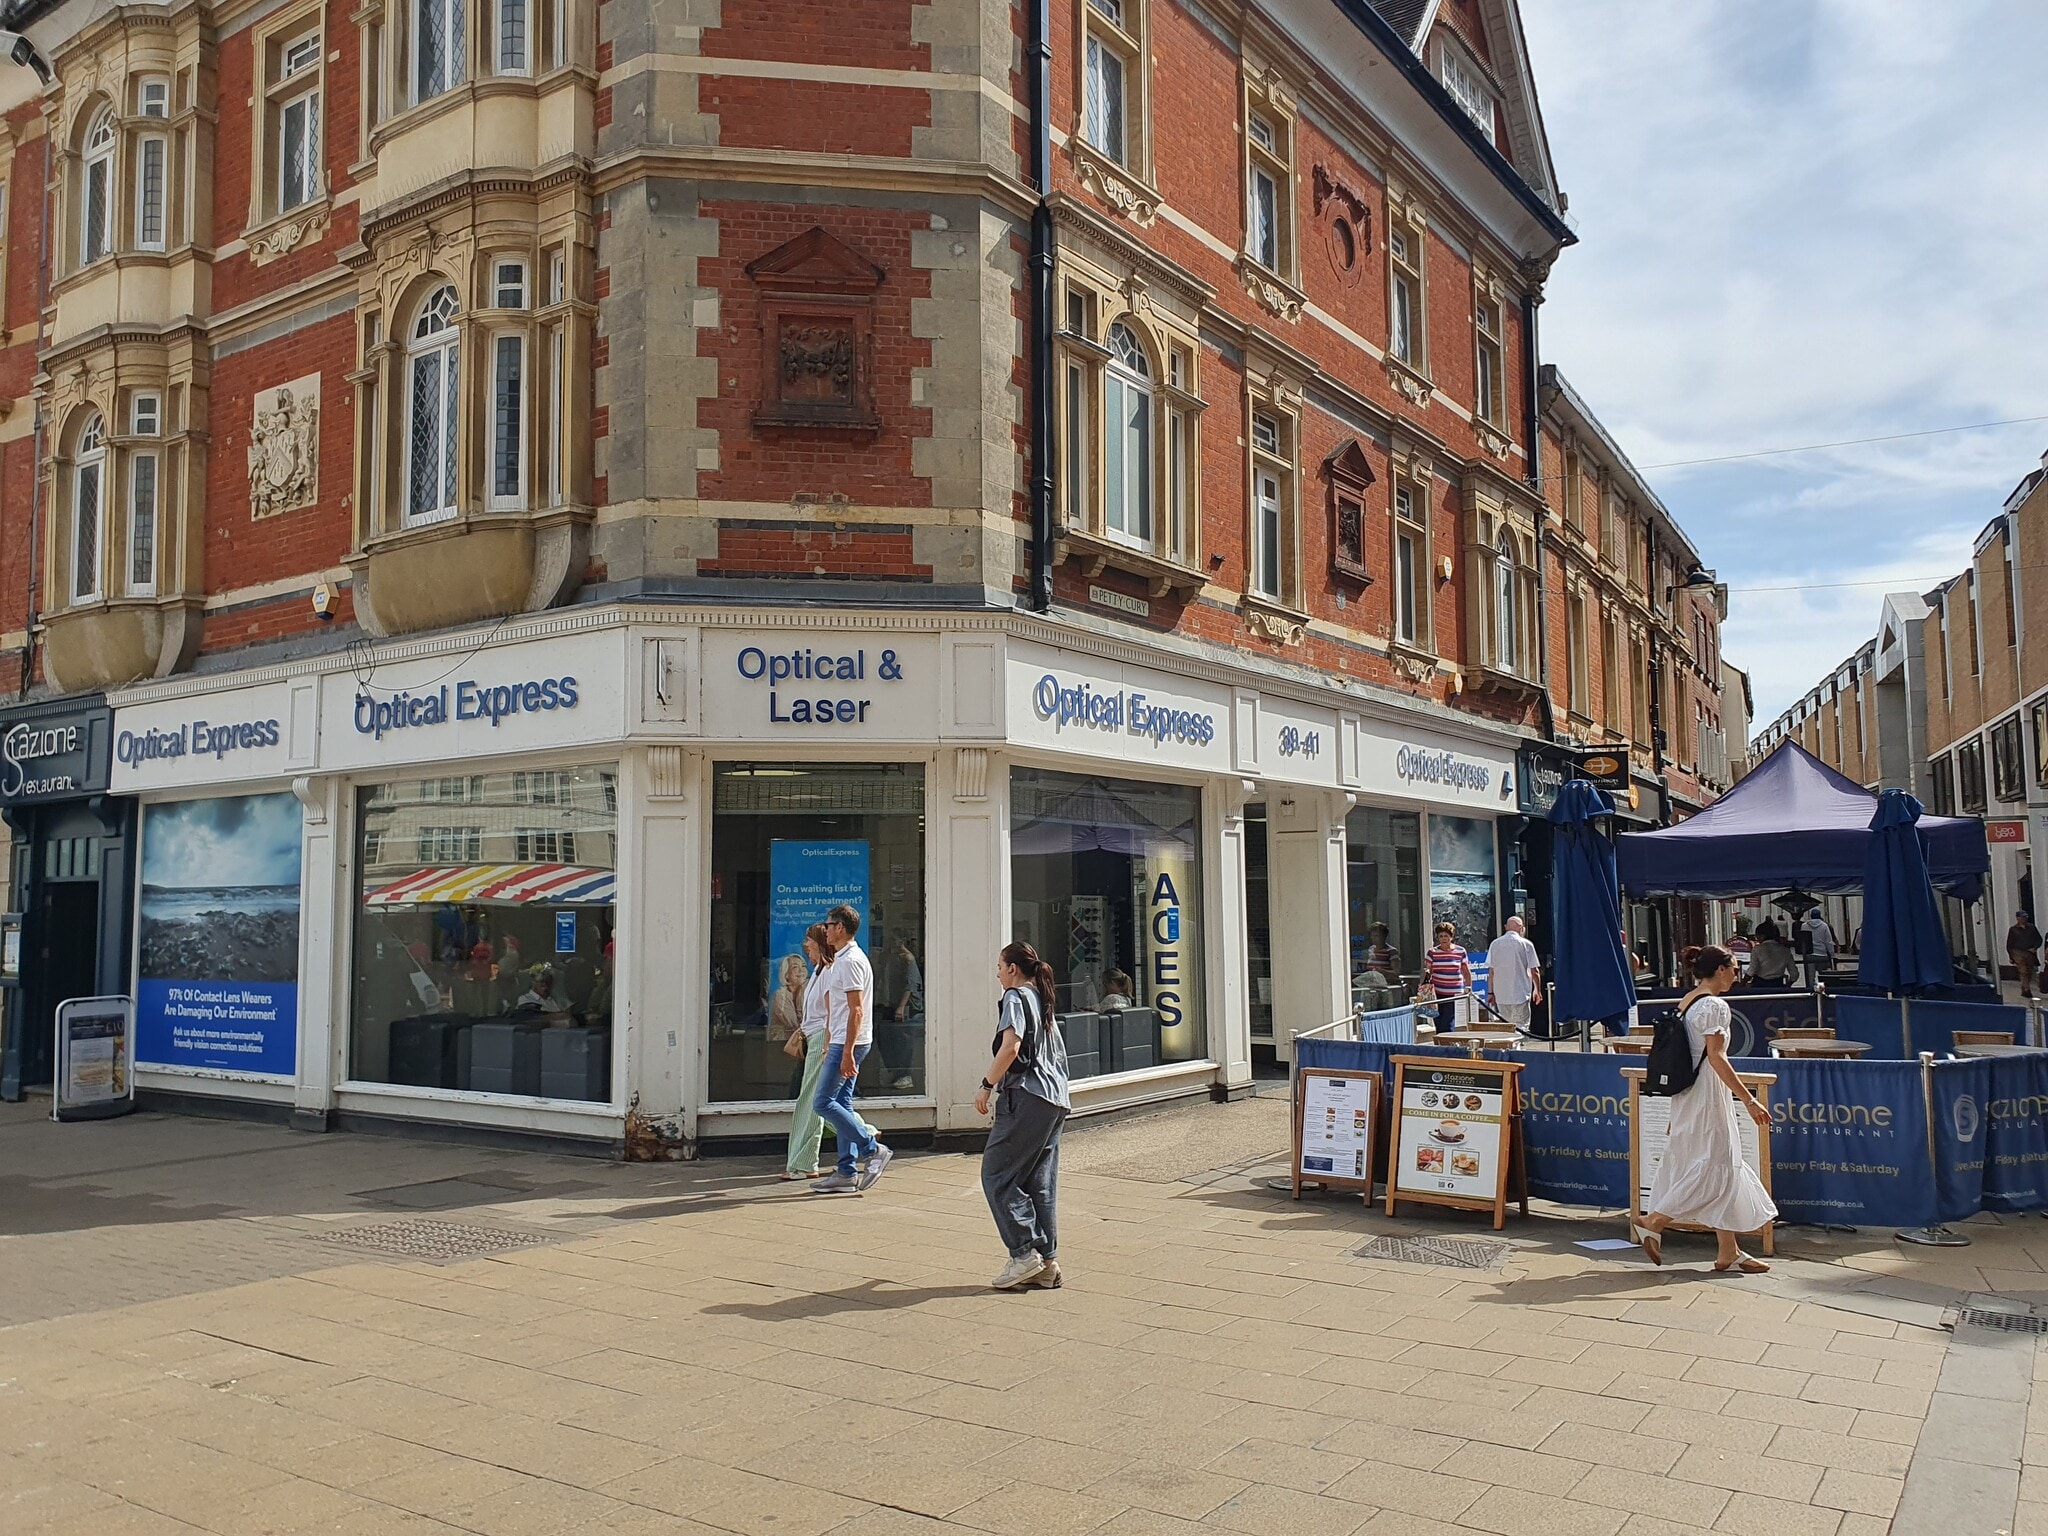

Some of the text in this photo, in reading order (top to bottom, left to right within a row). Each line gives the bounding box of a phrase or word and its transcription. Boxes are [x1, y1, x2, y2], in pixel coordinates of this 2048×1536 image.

[1099, 590, 1147, 614] PETTY CURY
[737, 647, 903, 687] Optical &
[354, 676, 578, 741] Optical Express
[770, 691, 871, 723] Laser
[1039, 674, 1214, 742] Optical Express
[117, 718, 280, 770] Optical Express
[2, 722, 77, 797] Stazione
[1400, 744, 1490, 790] Optical Express
[21, 774, 75, 797] restaurant
[801, 848, 860, 857] OpticalExpress
[777, 884, 791, 893] On
[800, 884, 833, 894] waiting
[834, 884, 848, 893] list
[849, 883, 862, 892] for
[776, 895, 863, 906] cataract treatment?
[168, 988, 272, 1005] 97% Of Contact Lens Wearers
[164, 1004, 177, 1016] Are
[177, 1004, 213, 1020] Damaging
[213, 1006, 228, 1018] Our
[173, 1026, 264, 1043] Ask us about more environmentally
[173, 1038, 263, 1053] friendly vision correction solutions
[1408, 1109, 1429, 1117] COME
[1773, 1097, 1893, 1127] stazione
[1775, 1126, 1895, 1138] RESTAURANT
[1550, 1145, 1581, 1159] Friday
[1584, 1148, 1592, 1158] &
[1595, 1148, 1630, 1160] Saturd
[1776, 1161, 1806, 1172] every
[1840, 1162, 1850, 1172] &
[1850, 1162, 1899, 1177] Saturday
